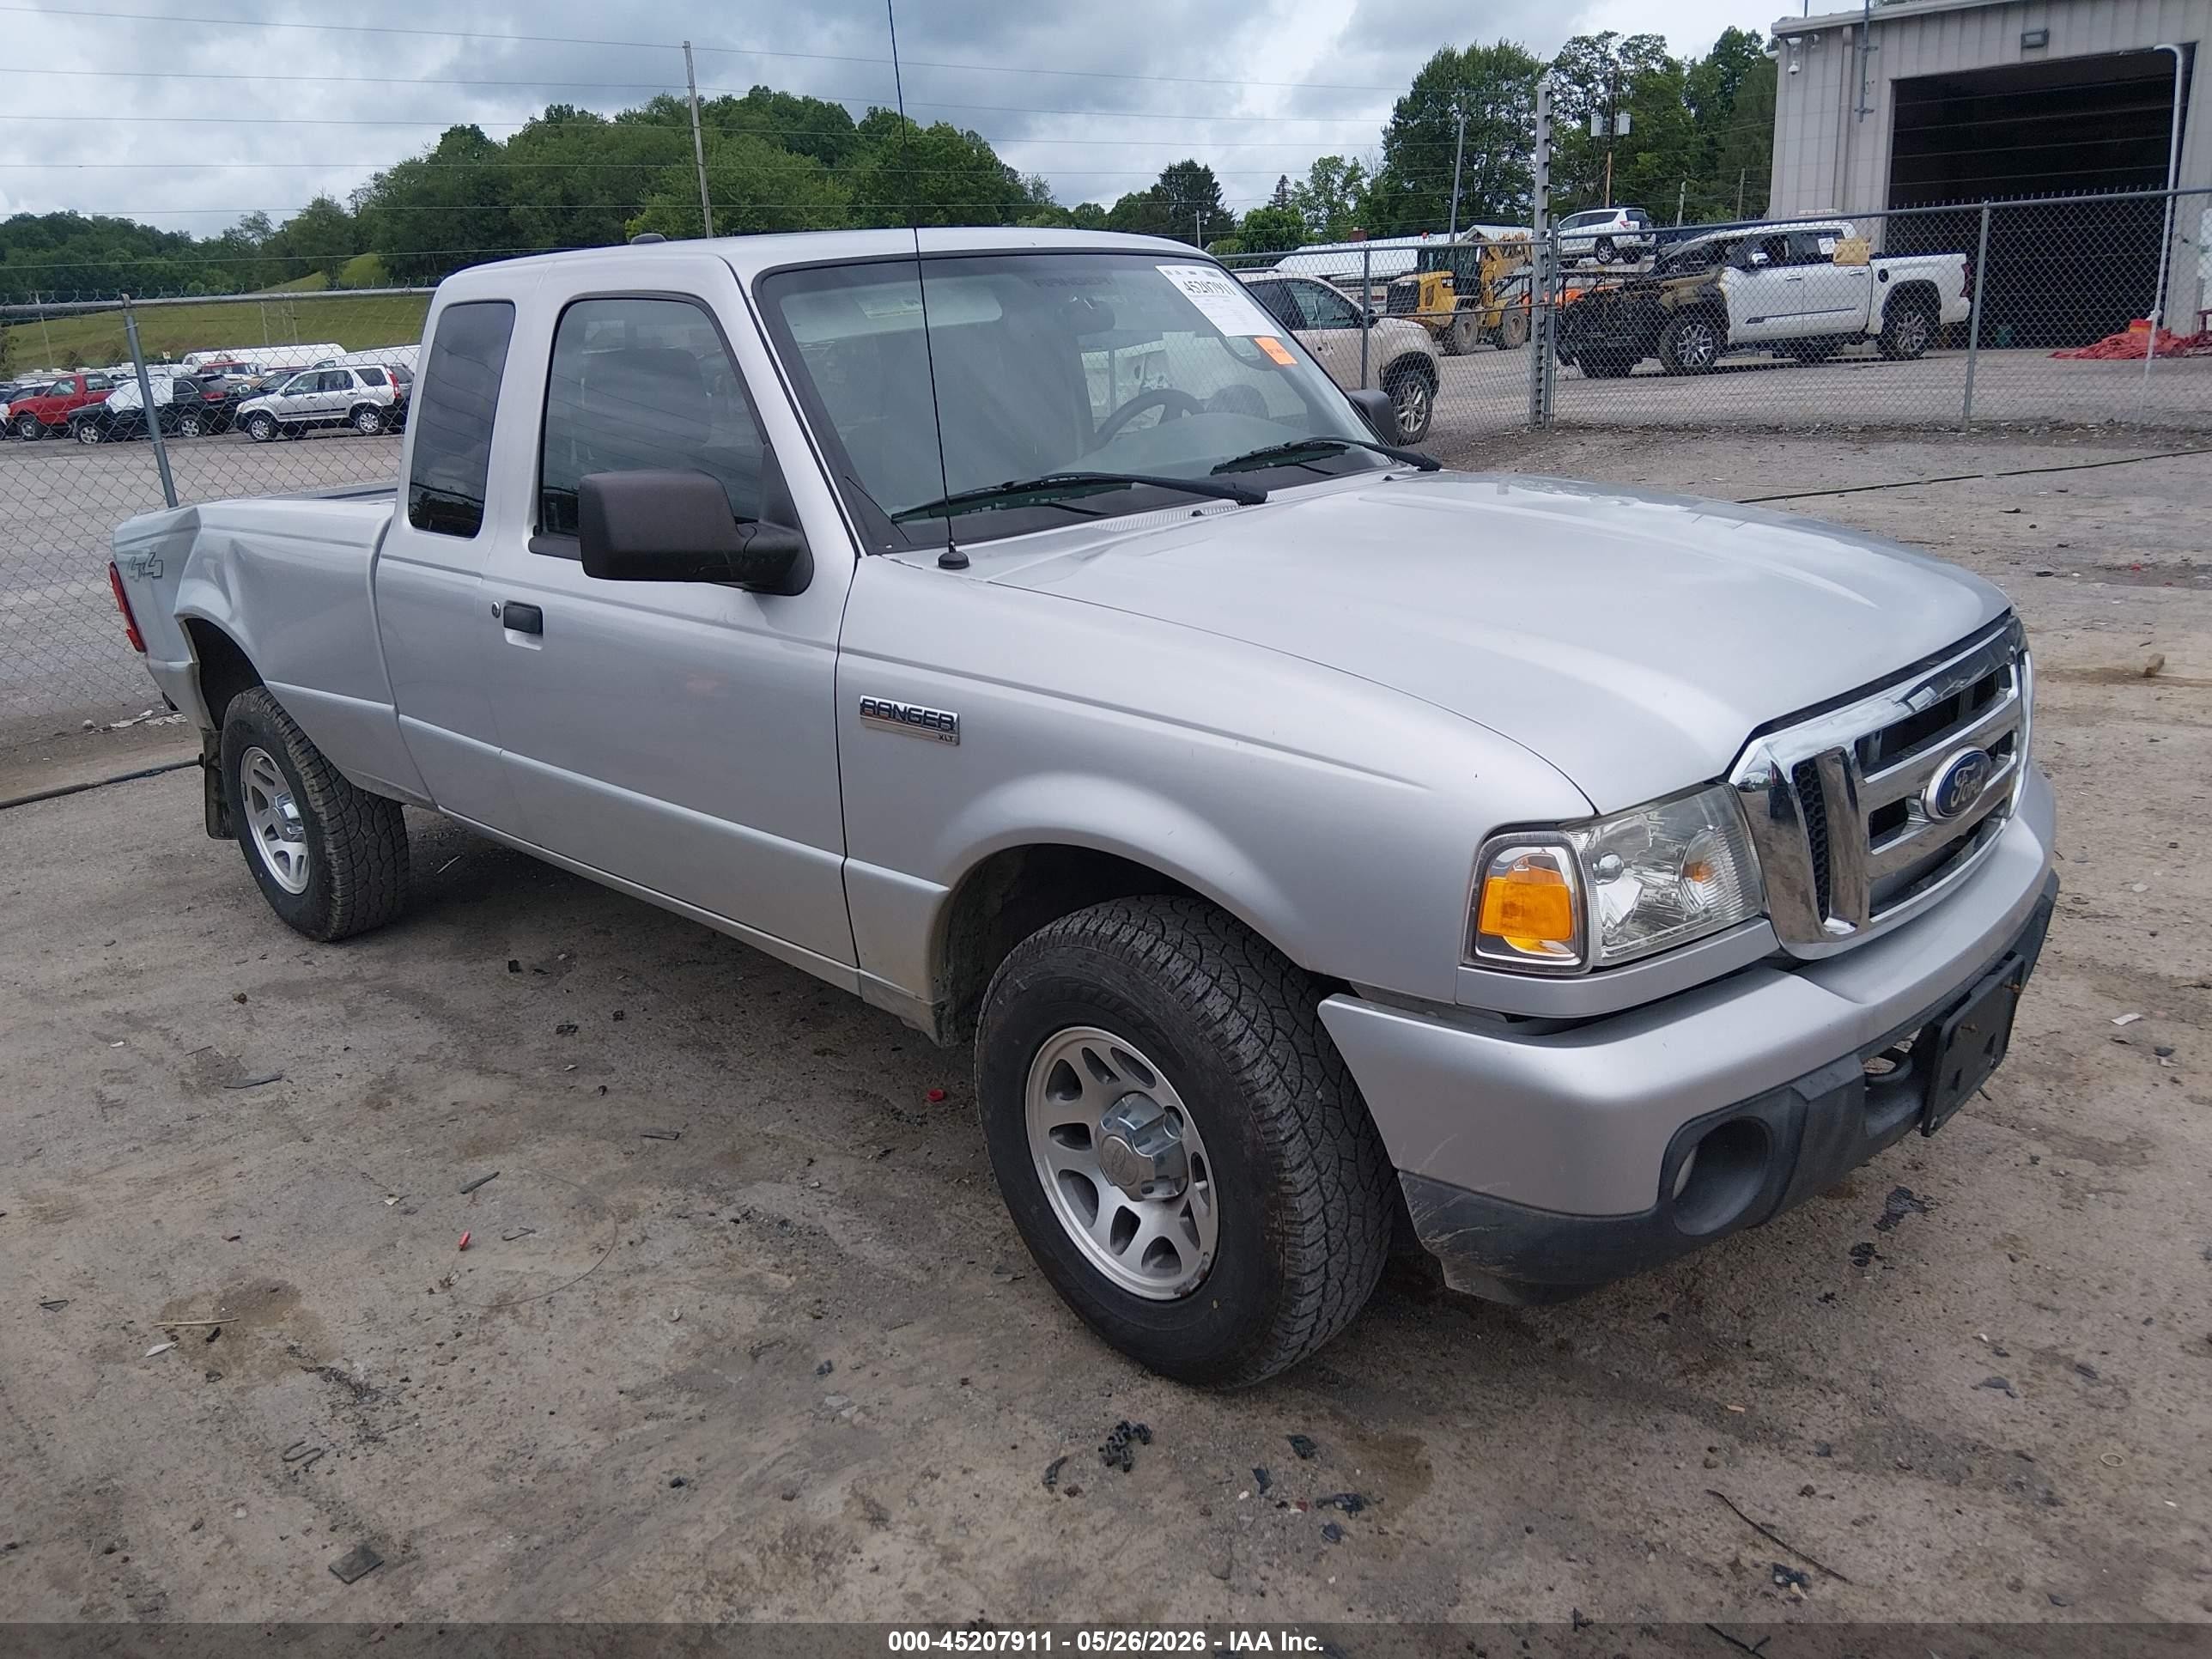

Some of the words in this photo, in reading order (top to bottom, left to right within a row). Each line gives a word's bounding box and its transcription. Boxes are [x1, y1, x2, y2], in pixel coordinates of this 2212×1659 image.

[1182, 281, 1237, 296] 45207911
[860, 697, 957, 731] RANGER
[938, 734, 955, 743] XLT
[1949, 762, 1985, 808] Ford
